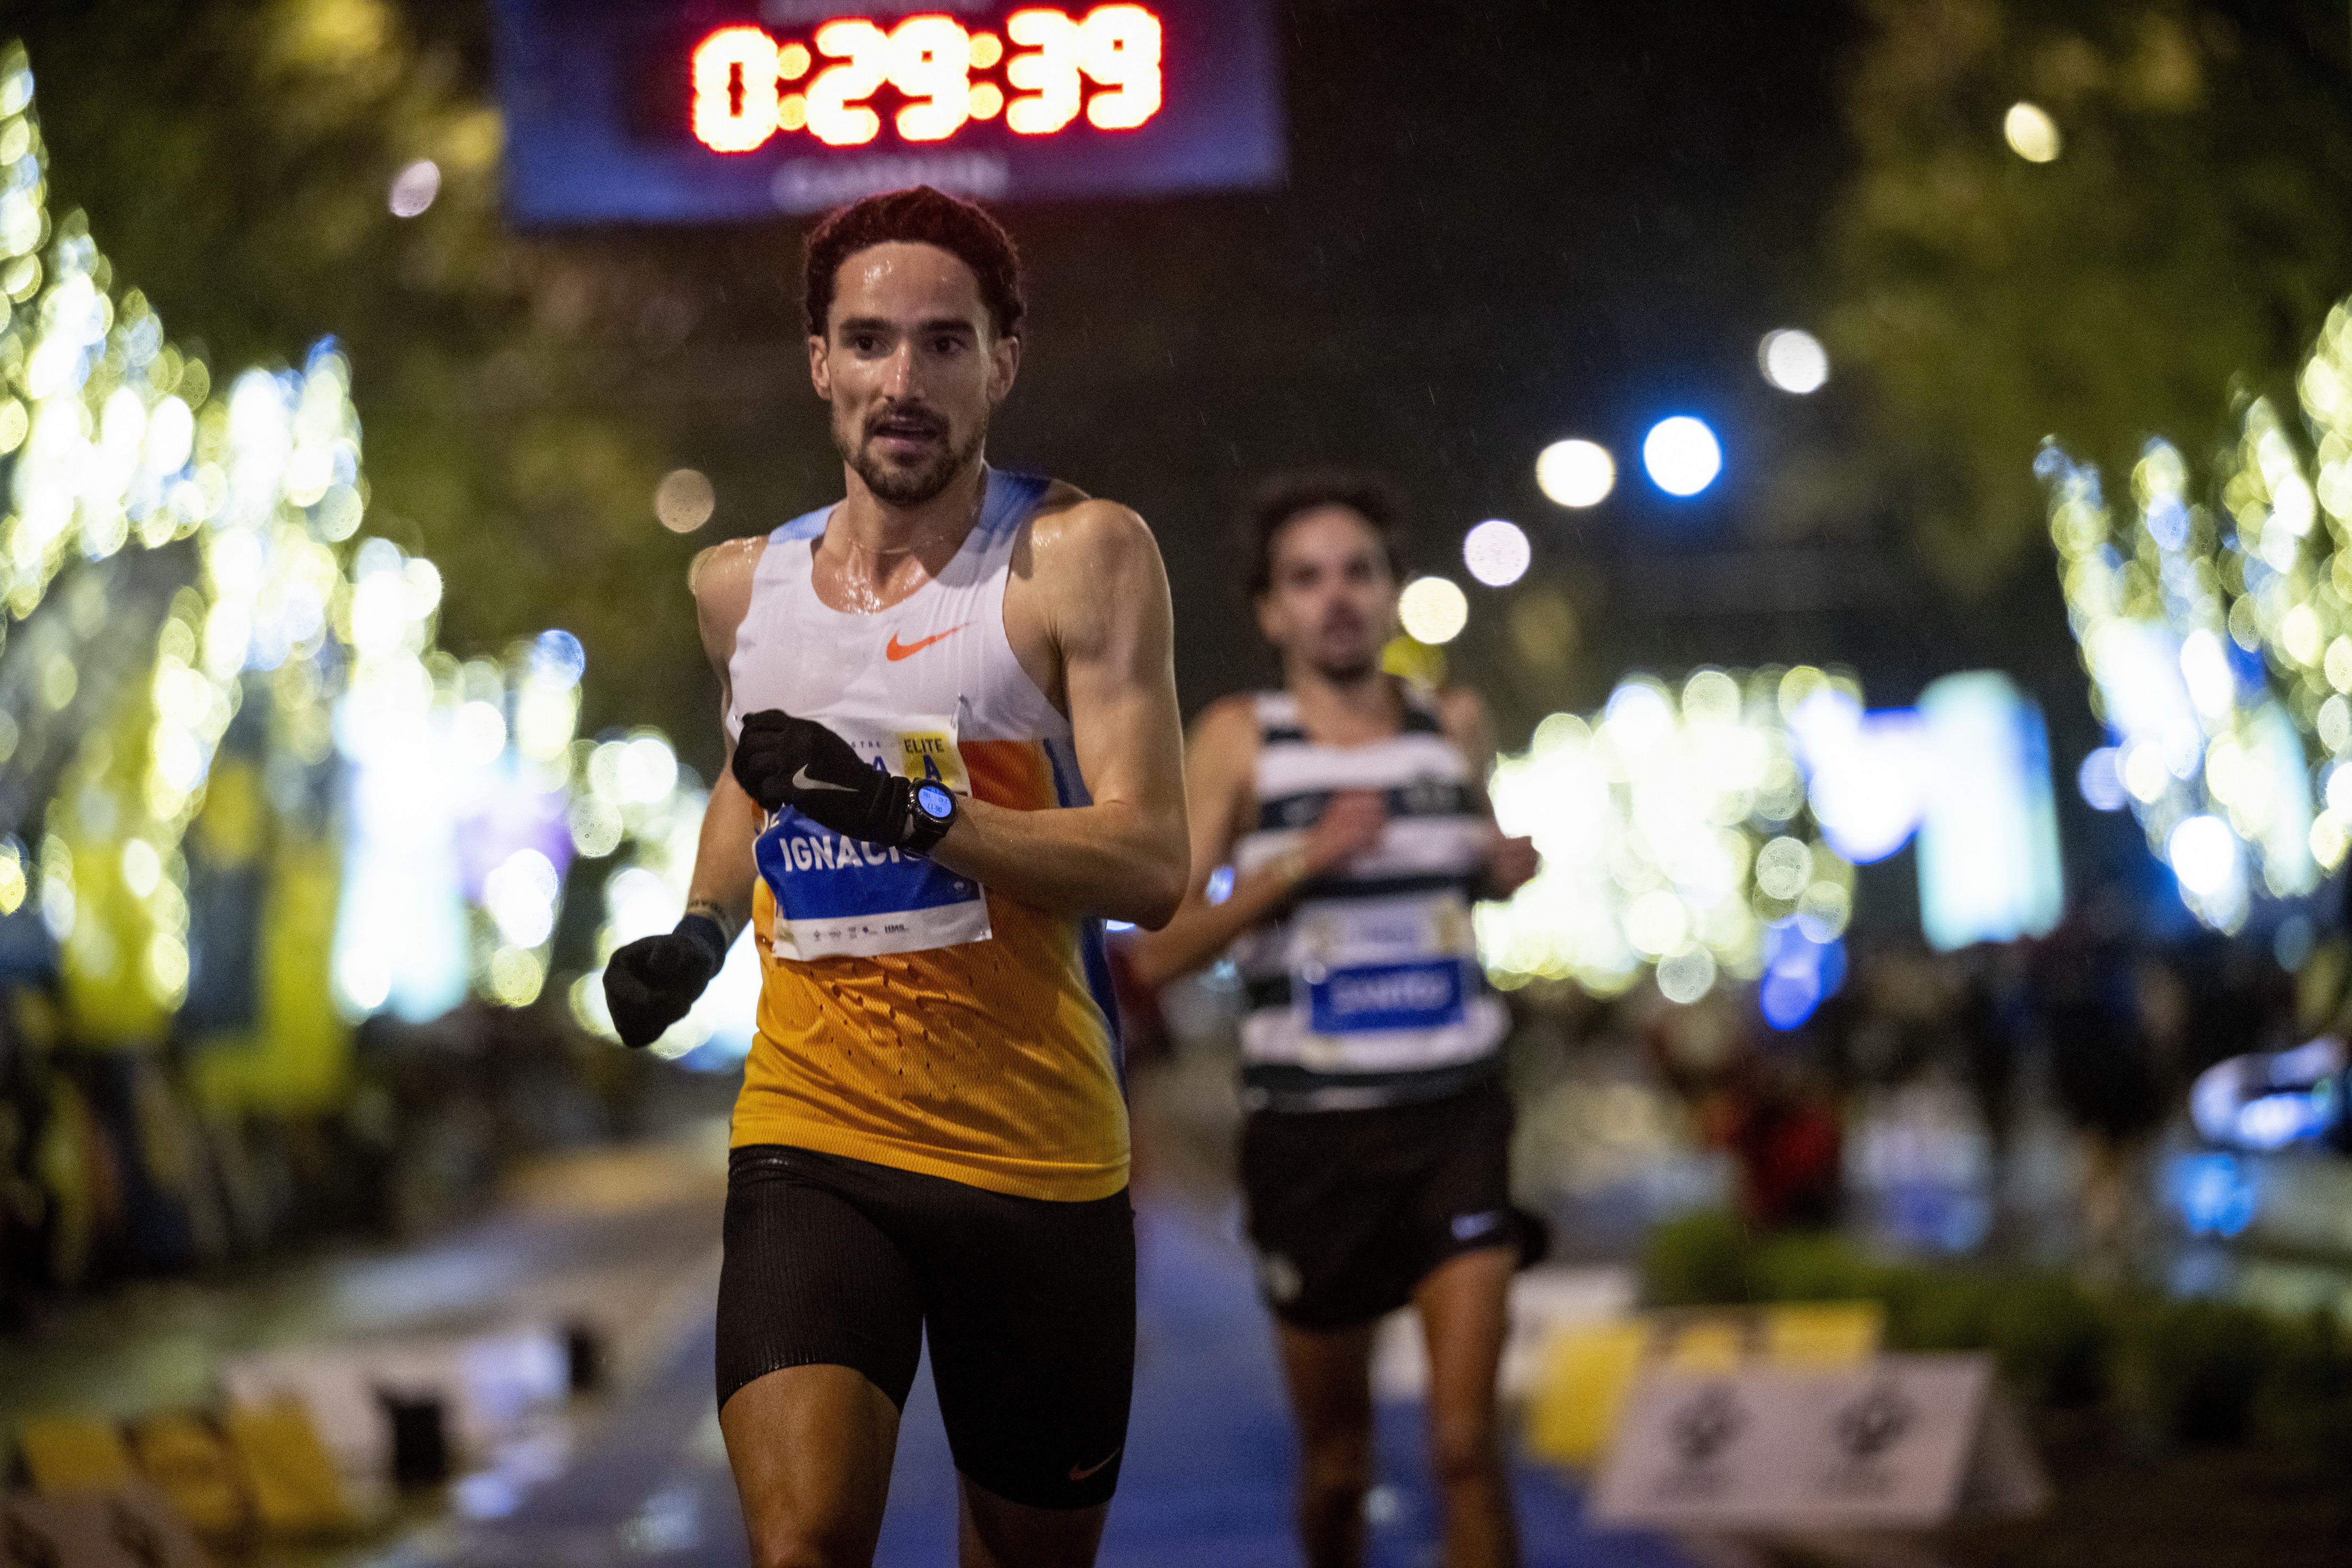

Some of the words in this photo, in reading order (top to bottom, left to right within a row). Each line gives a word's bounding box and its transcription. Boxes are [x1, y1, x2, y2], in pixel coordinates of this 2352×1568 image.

[691, 3, 1163, 153] 0:29:39
[904, 738, 945, 754] ELITE
[923, 754, 942, 782] A
[779, 835, 923, 872] IGNACI
